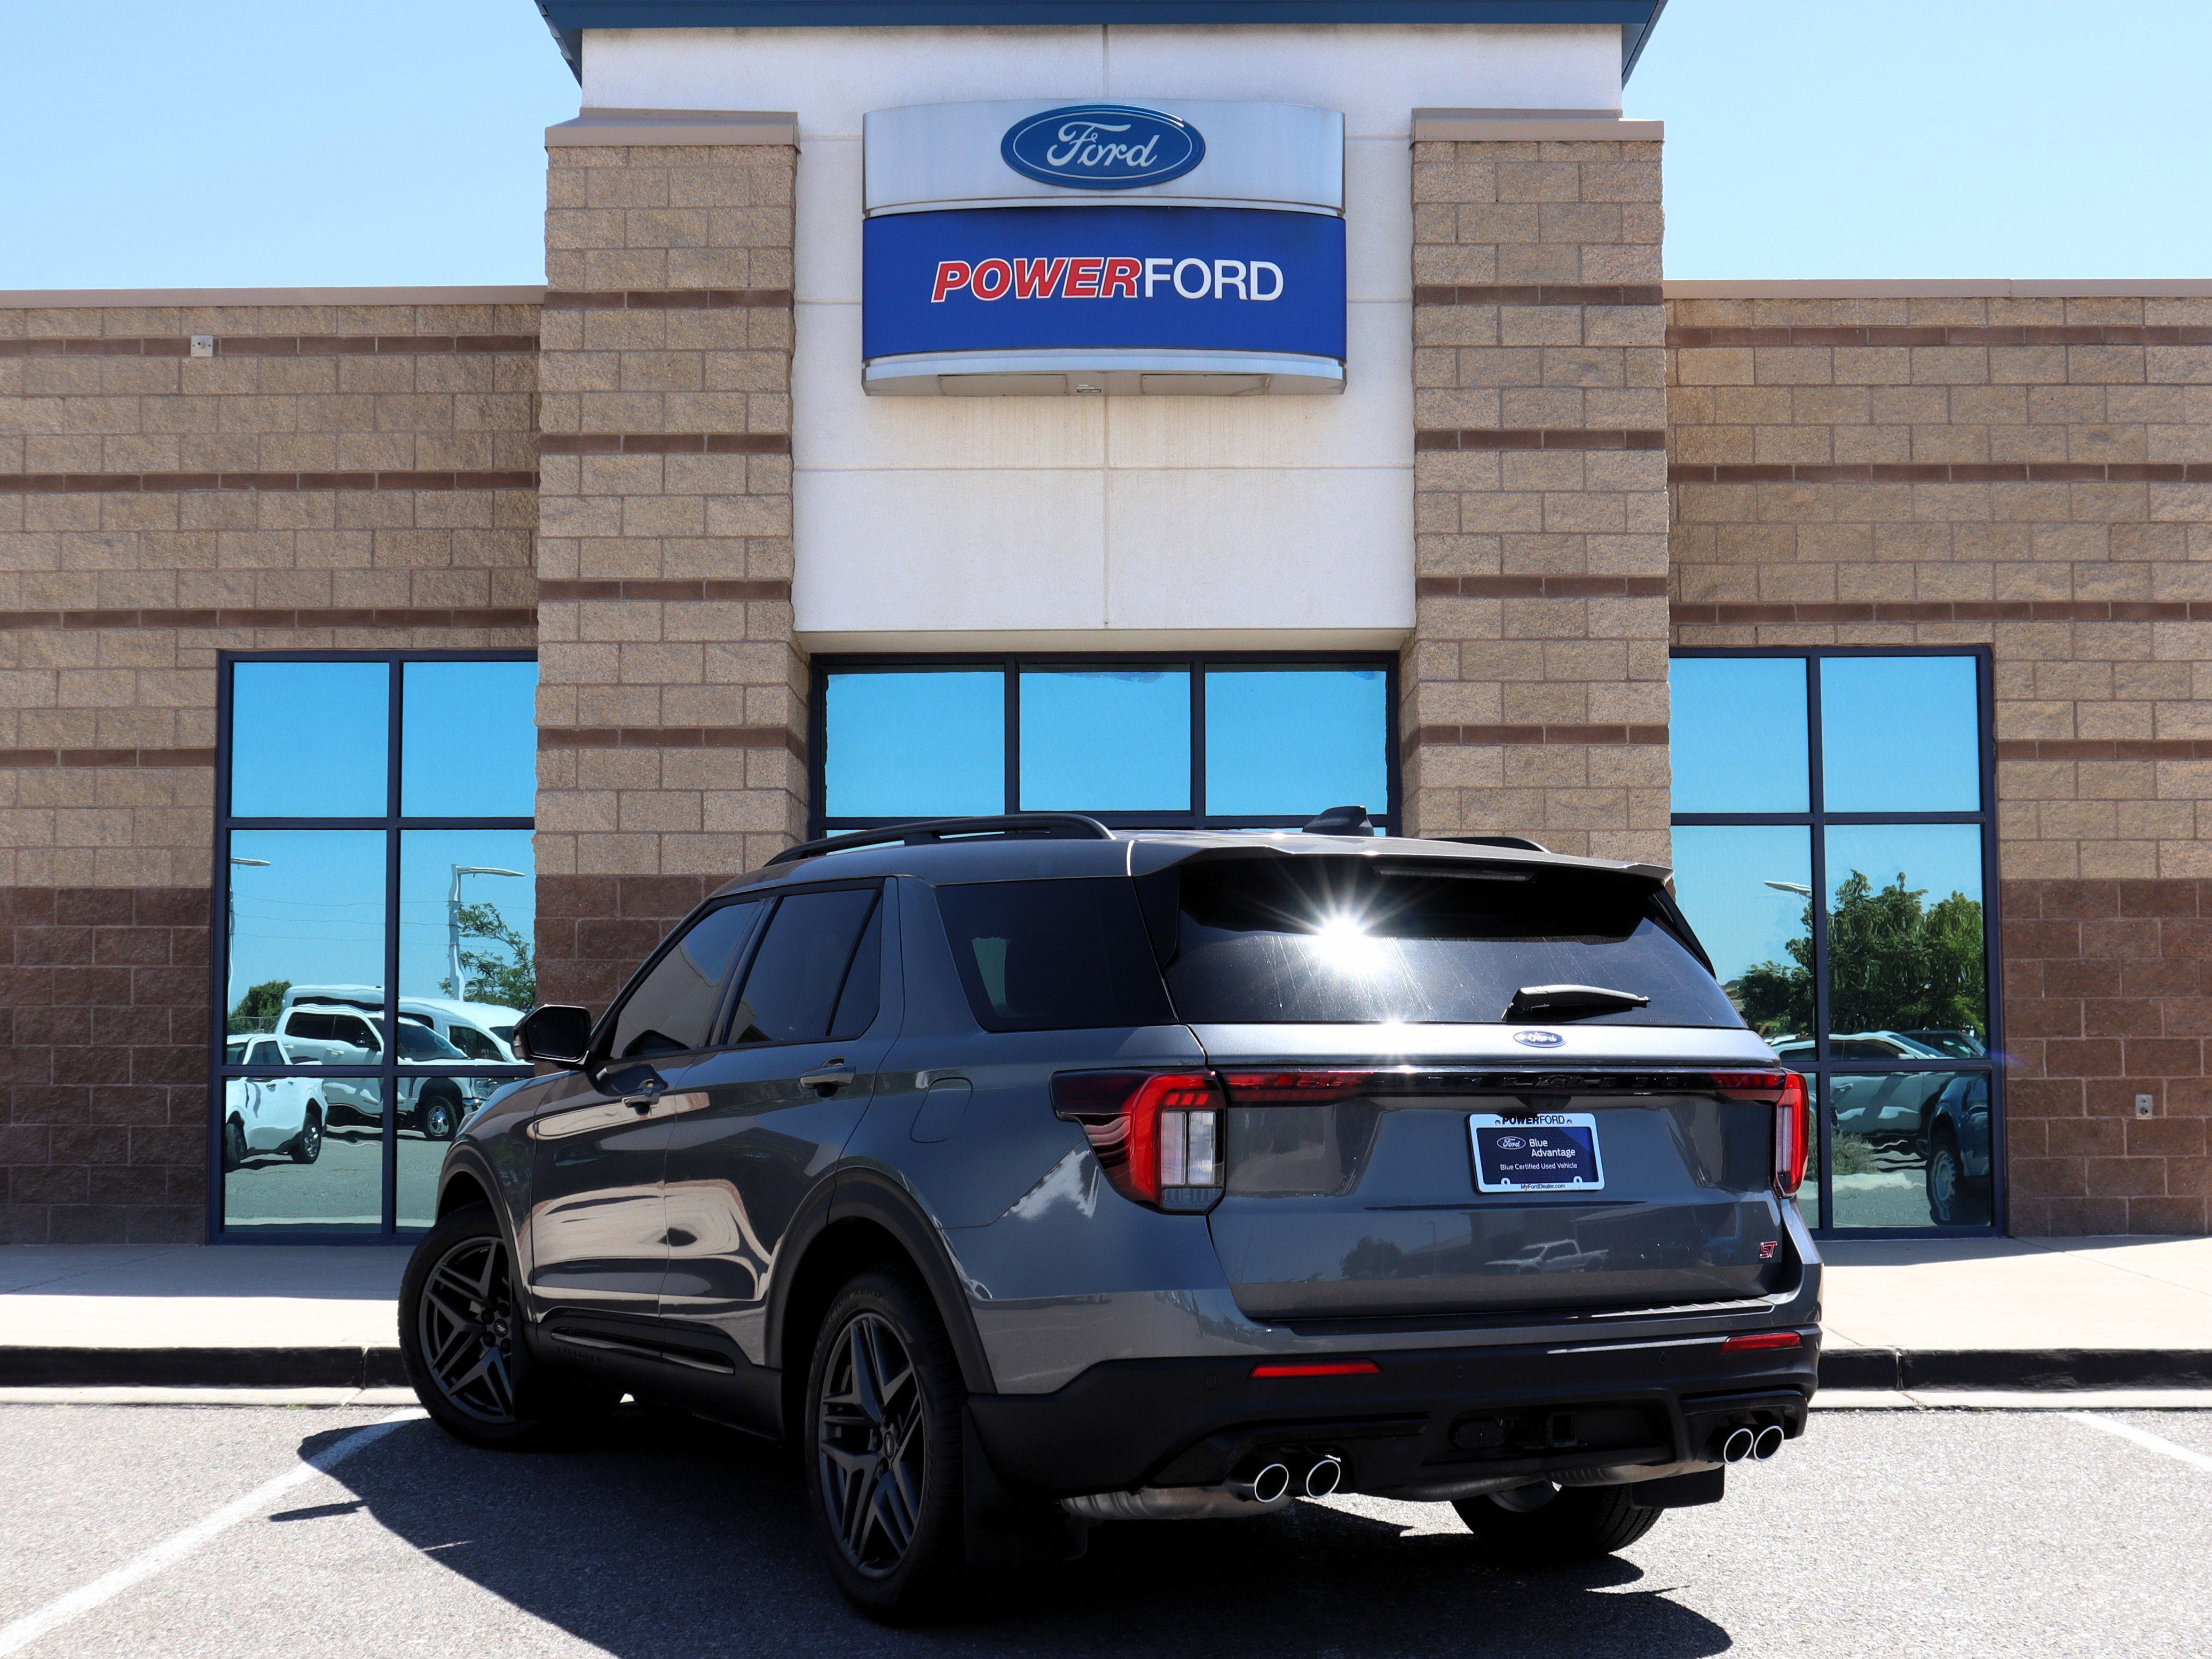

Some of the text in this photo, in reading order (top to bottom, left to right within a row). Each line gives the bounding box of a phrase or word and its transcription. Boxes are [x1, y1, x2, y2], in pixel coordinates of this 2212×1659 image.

[1045, 121, 1160, 168] Ford
[931, 256, 1284, 303] POWERFORD
[1502, 1115, 1565, 1125] POWERFORD
[1502, 1138, 1548, 1147] Ford Blue
[1531, 1148, 1576, 1158] Advantage
[1521, 1183, 1565, 1191] MyFordDealer.com
[1760, 1241, 1778, 1259] ST
